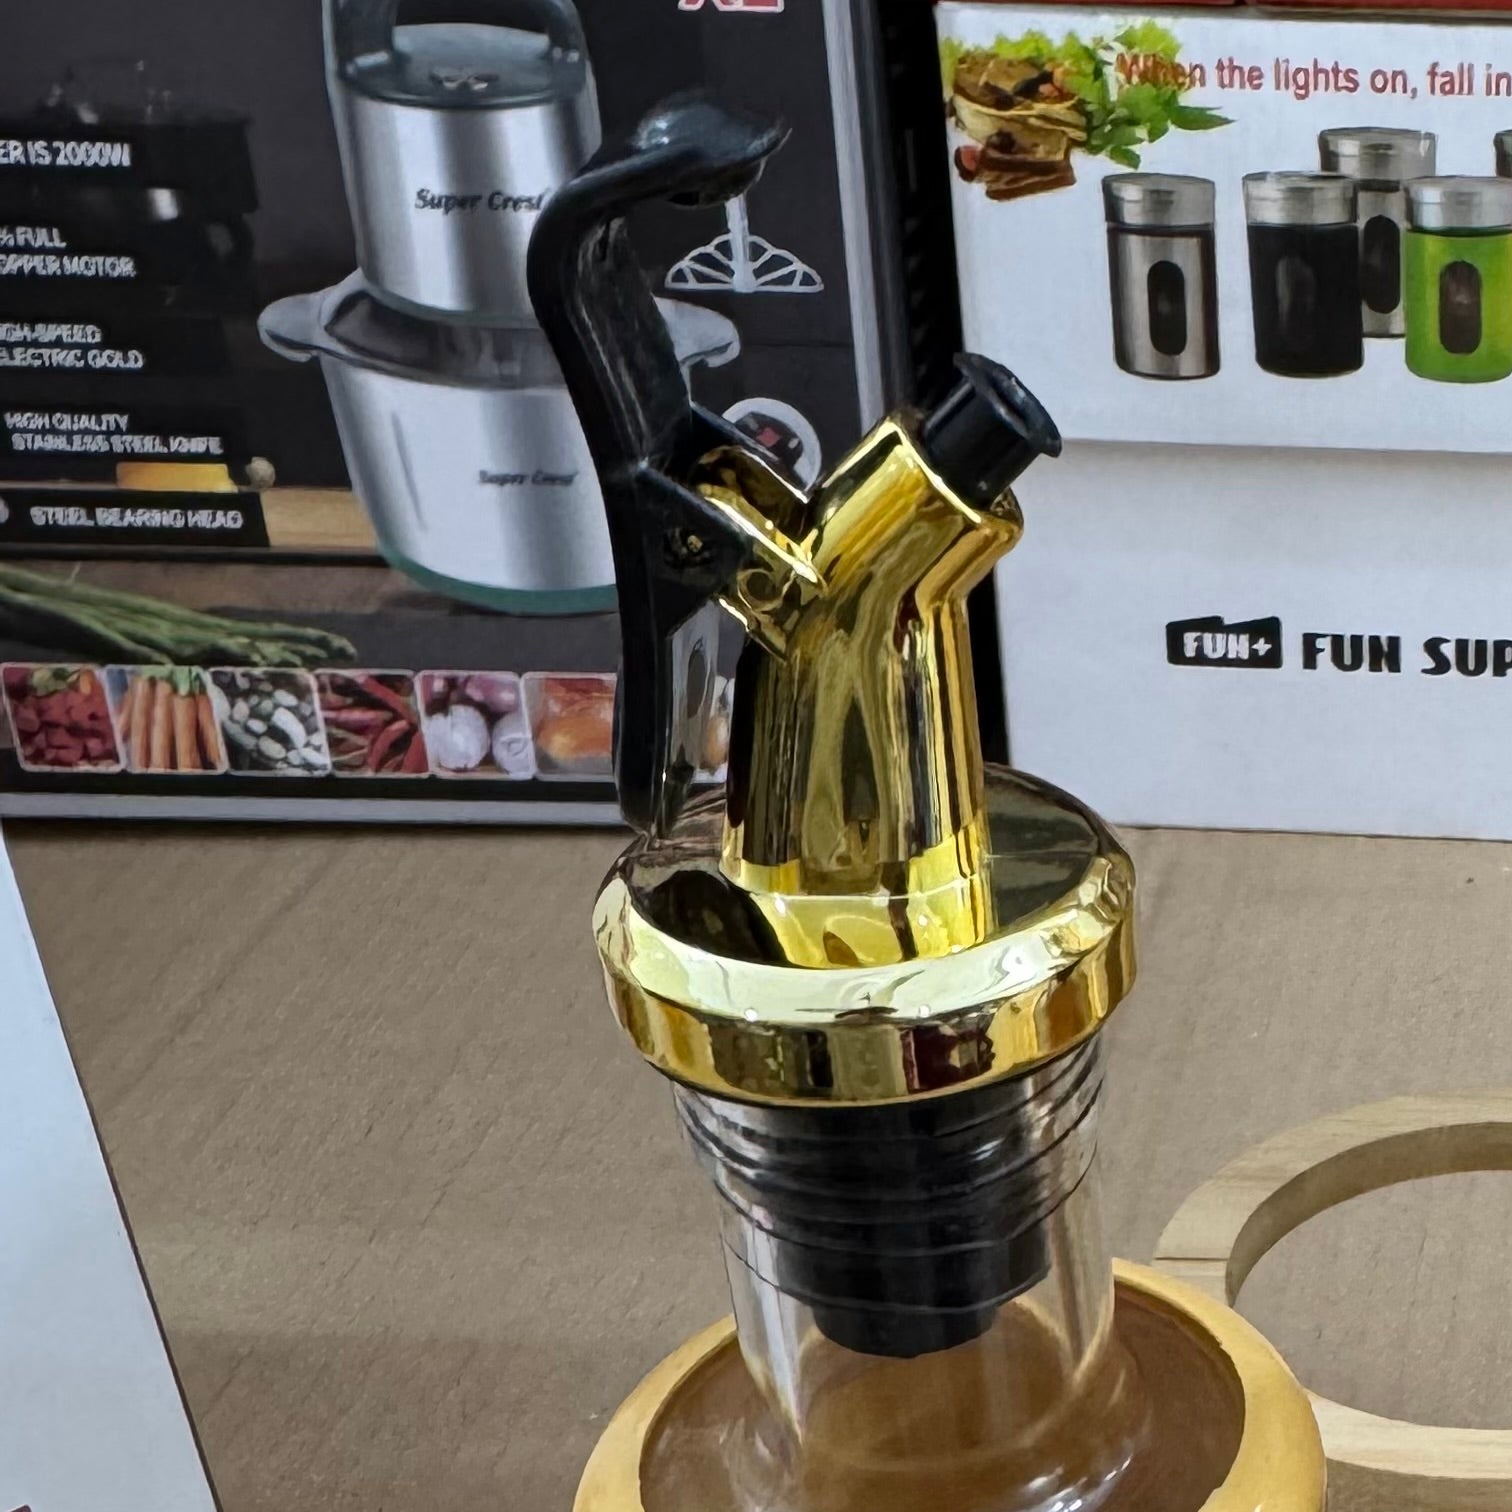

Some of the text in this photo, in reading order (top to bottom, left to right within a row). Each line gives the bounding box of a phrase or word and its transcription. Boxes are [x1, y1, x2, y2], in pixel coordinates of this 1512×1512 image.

[1114, 52, 1206, 88] When
[1216, 57, 1263, 90] the
[1273, 57, 1359, 100] lights
[1370, 68, 1418, 99] on,
[1426, 62, 1475, 96] fall
[1485, 63, 1512, 98] in
[414, 188, 482, 216] Super
[16, 226, 67, 248] FULL
[63, 255, 136, 278] MOTOR
[1182, 631, 1273, 660] FUN+
[1302, 632, 1401, 673] FUN
